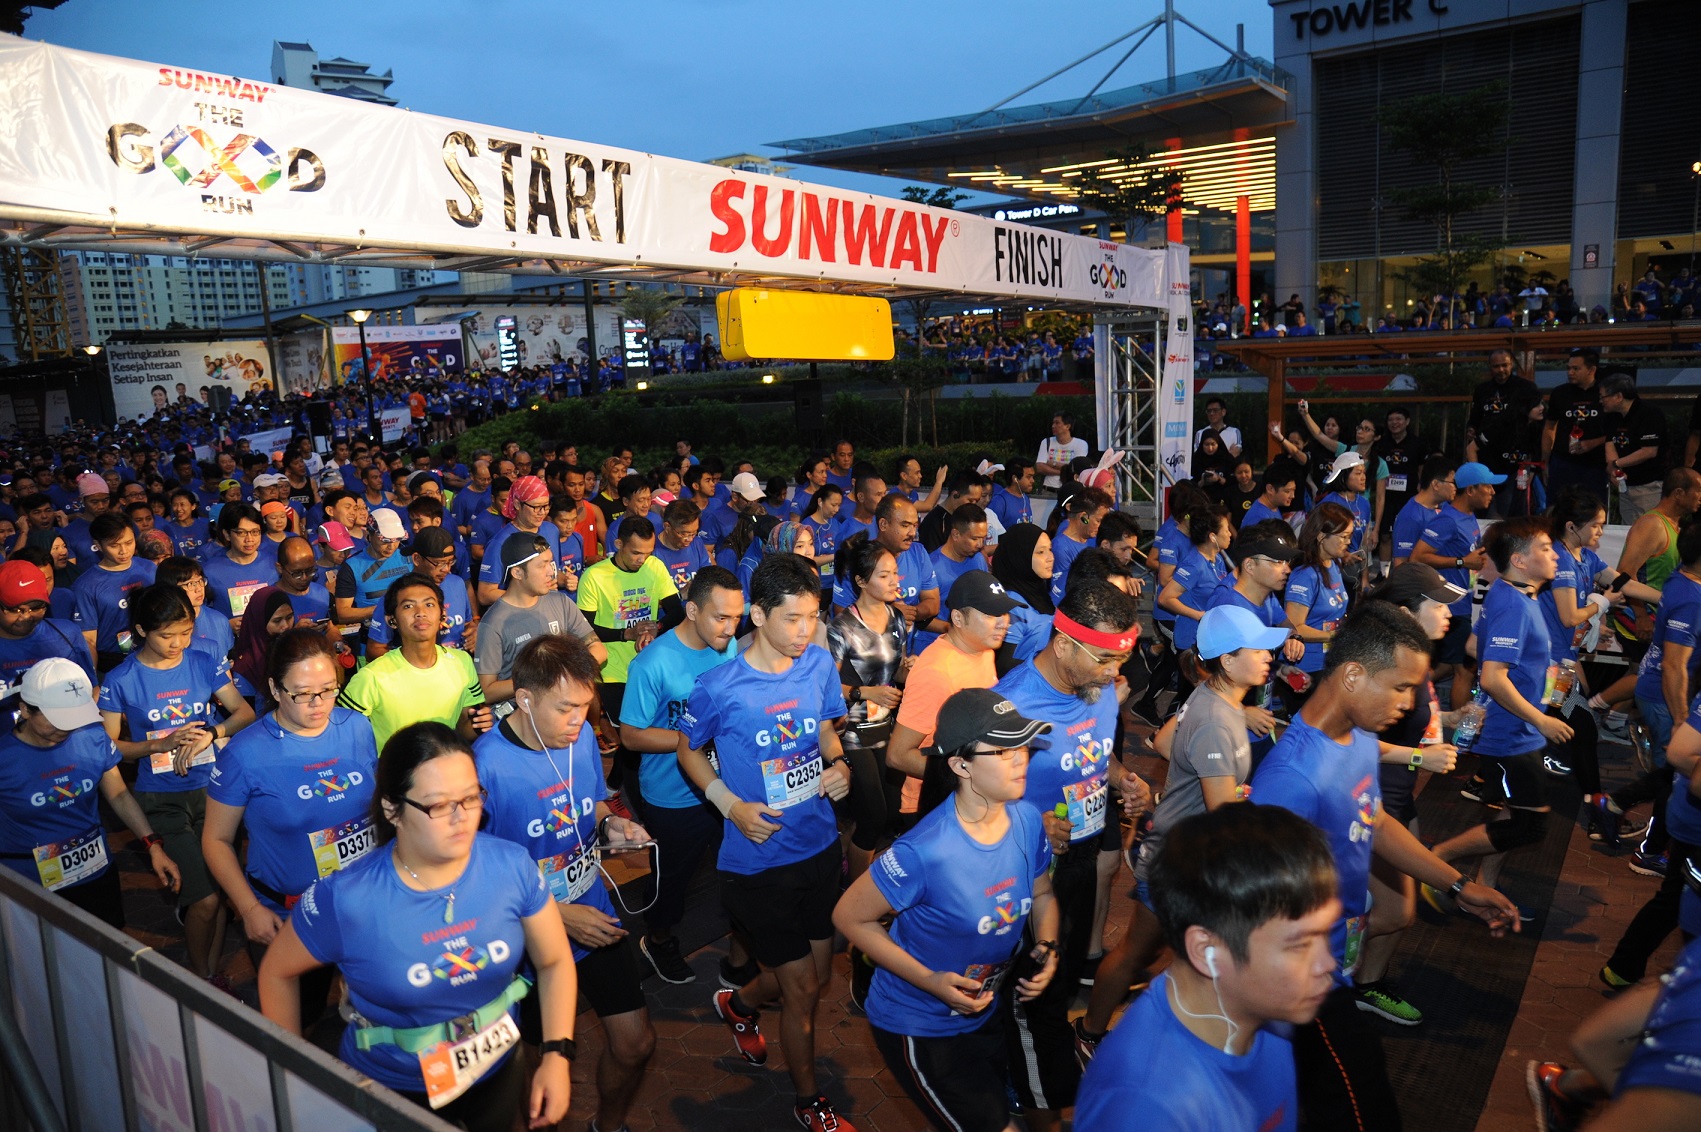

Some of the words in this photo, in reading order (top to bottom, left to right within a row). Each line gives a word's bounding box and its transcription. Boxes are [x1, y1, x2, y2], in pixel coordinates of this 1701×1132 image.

[1290, 0, 1413, 39] TOWER
[158, 68, 270, 103] SUNWAY
[194, 102, 244, 128] THE
[442, 130, 631, 244] START
[201, 194, 254, 216] RUN
[1007, 209, 1032, 221] Tower
[1033, 207, 1042, 217] D
[1042, 206, 1058, 216] Car
[709, 179, 950, 274] SUNWAY
[994, 226, 1063, 289] FINISH
[1104, 253, 1114, 263] THE
[1104, 290, 1115, 299] RUN
[110, 349, 181, 361] Pertingkatkan
[112, 360, 182, 373] Kesejahteraan
[114, 373, 145, 385] Setiap
[147, 372, 174, 382] Insan
[156, 689, 189, 699] SUNWAY
[168, 697, 182, 705] THE
[170, 718, 186, 726] RUN
[776, 712, 792, 722] THE
[1078, 732, 1092, 743] THE
[781, 741, 798, 752] RUN
[318, 768, 334, 778] THE
[785, 760, 821, 789] C2352
[1081, 765, 1096, 777] RUN
[54, 775, 70, 785] THE
[59, 798, 75, 809] RUN
[328, 792, 346, 804] RUN
[551, 793, 568, 807] THE
[555, 826, 574, 840] RUN
[337, 826, 376, 860] D3371
[61, 839, 102, 871] D3031
[995, 892, 1012, 904] THE
[421, 919, 478, 945] SUNWAY
[442, 936, 469, 952] THE
[450, 971, 478, 988] RUN
[454, 1021, 514, 1070] B1423
